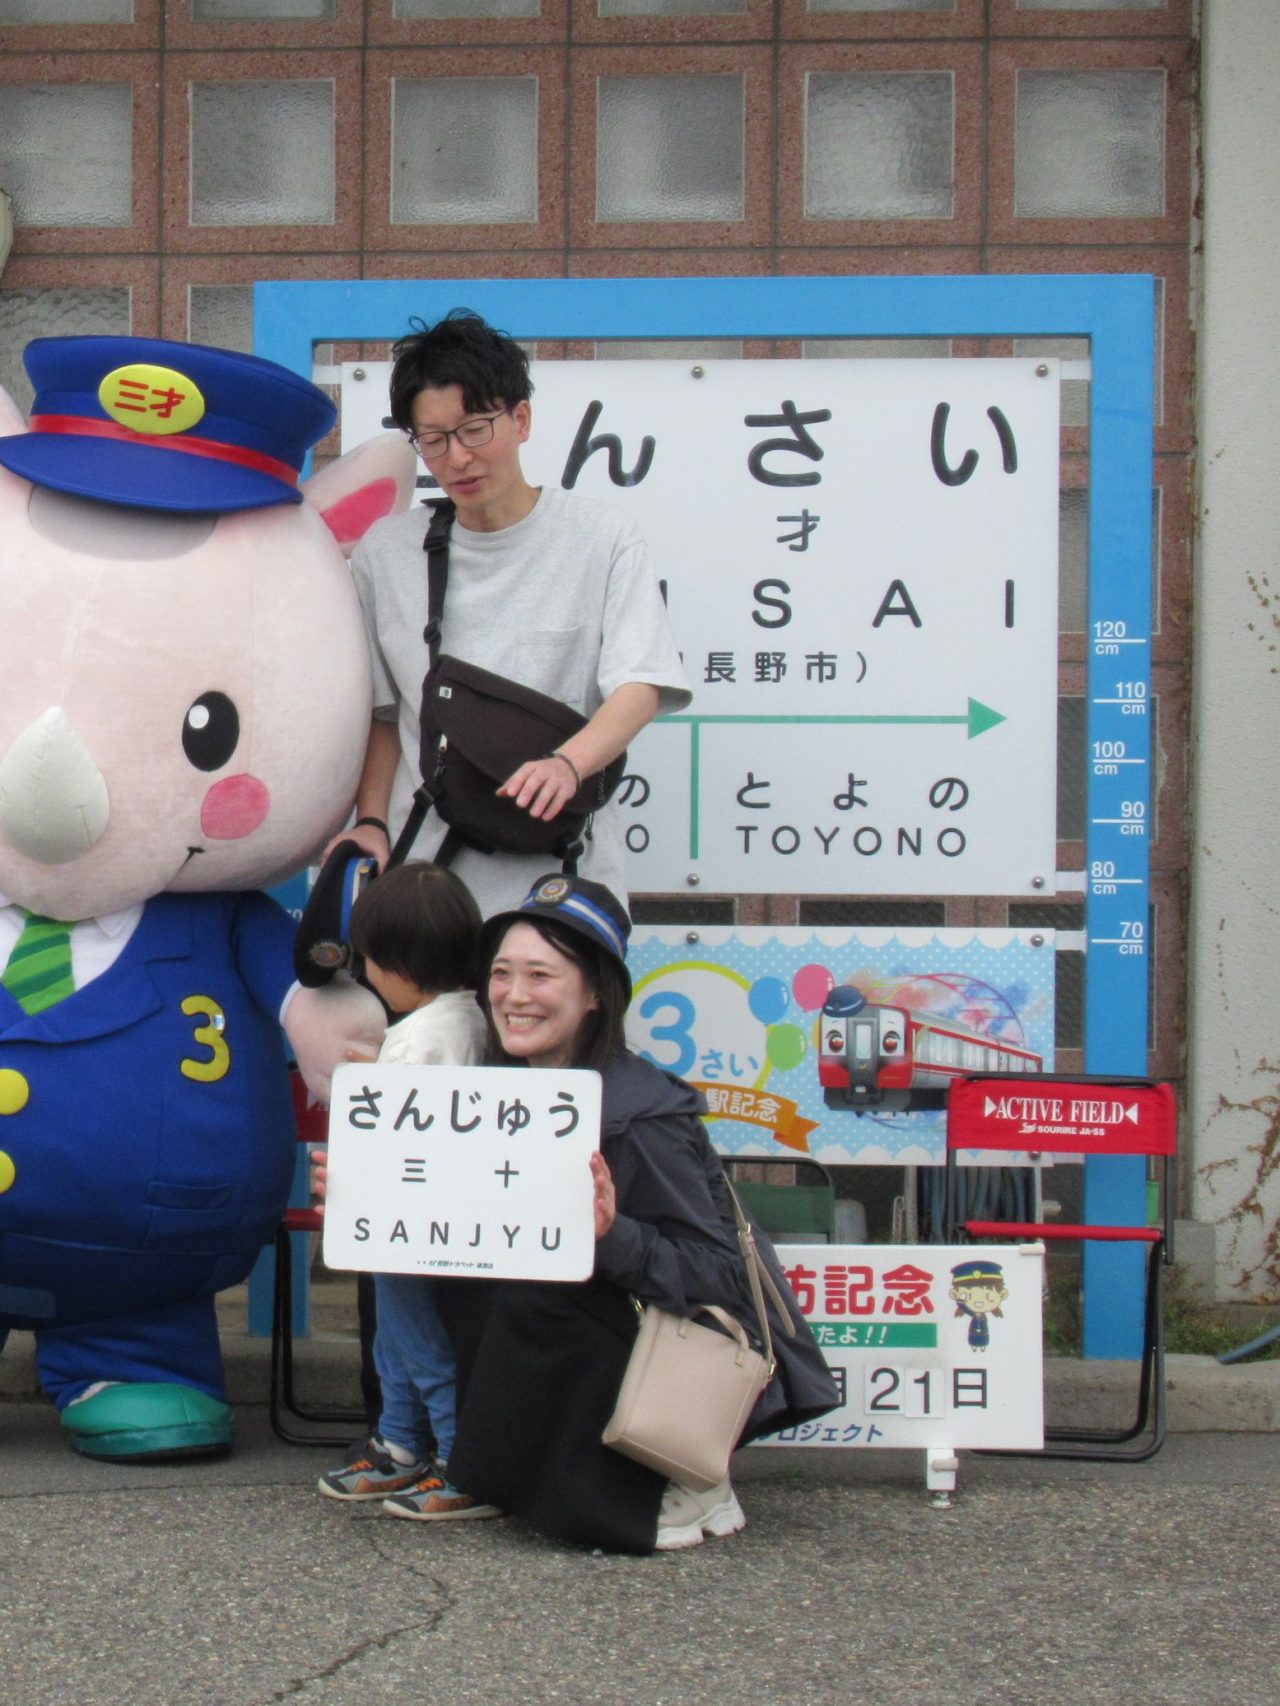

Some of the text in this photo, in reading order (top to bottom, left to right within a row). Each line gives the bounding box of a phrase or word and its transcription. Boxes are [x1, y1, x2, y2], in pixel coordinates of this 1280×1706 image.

[114, 378, 187, 419] 三才
[382, 398, 1017, 488] んさい
[658, 577, 1016, 630] SAI
[1094, 621, 1126, 638] 120
[1095, 644, 1119, 656] cm
[679, 650, 868, 684] 長野市)
[1115, 682, 1146, 699] 110
[1121, 704, 1146, 716] cm
[1093, 742, 1125, 759] 100
[1094, 764, 1118, 776] cm
[736, 771, 970, 815] とよの
[1121, 802, 1146, 819] 90
[1120, 824, 1145, 836] cm
[735, 825, 968, 860] TOYONO
[1091, 862, 1115, 879] 80
[1092, 884, 1117, 896] cm
[1119, 922, 1144, 939] 70
[1119, 944, 1144, 956] cm
[179, 993, 231, 1084] 3
[348, 1085, 580, 1138] さんじゅう
[995, 1096, 1125, 1124] ACTIVE FIELD
[1037, 1125, 1077, 1135] SOURIRE
[353, 1217, 562, 1252] SANJYU
[811, 1325, 887, 1345] たよ!!
[760, 1423, 883, 1443] ロジェクト
